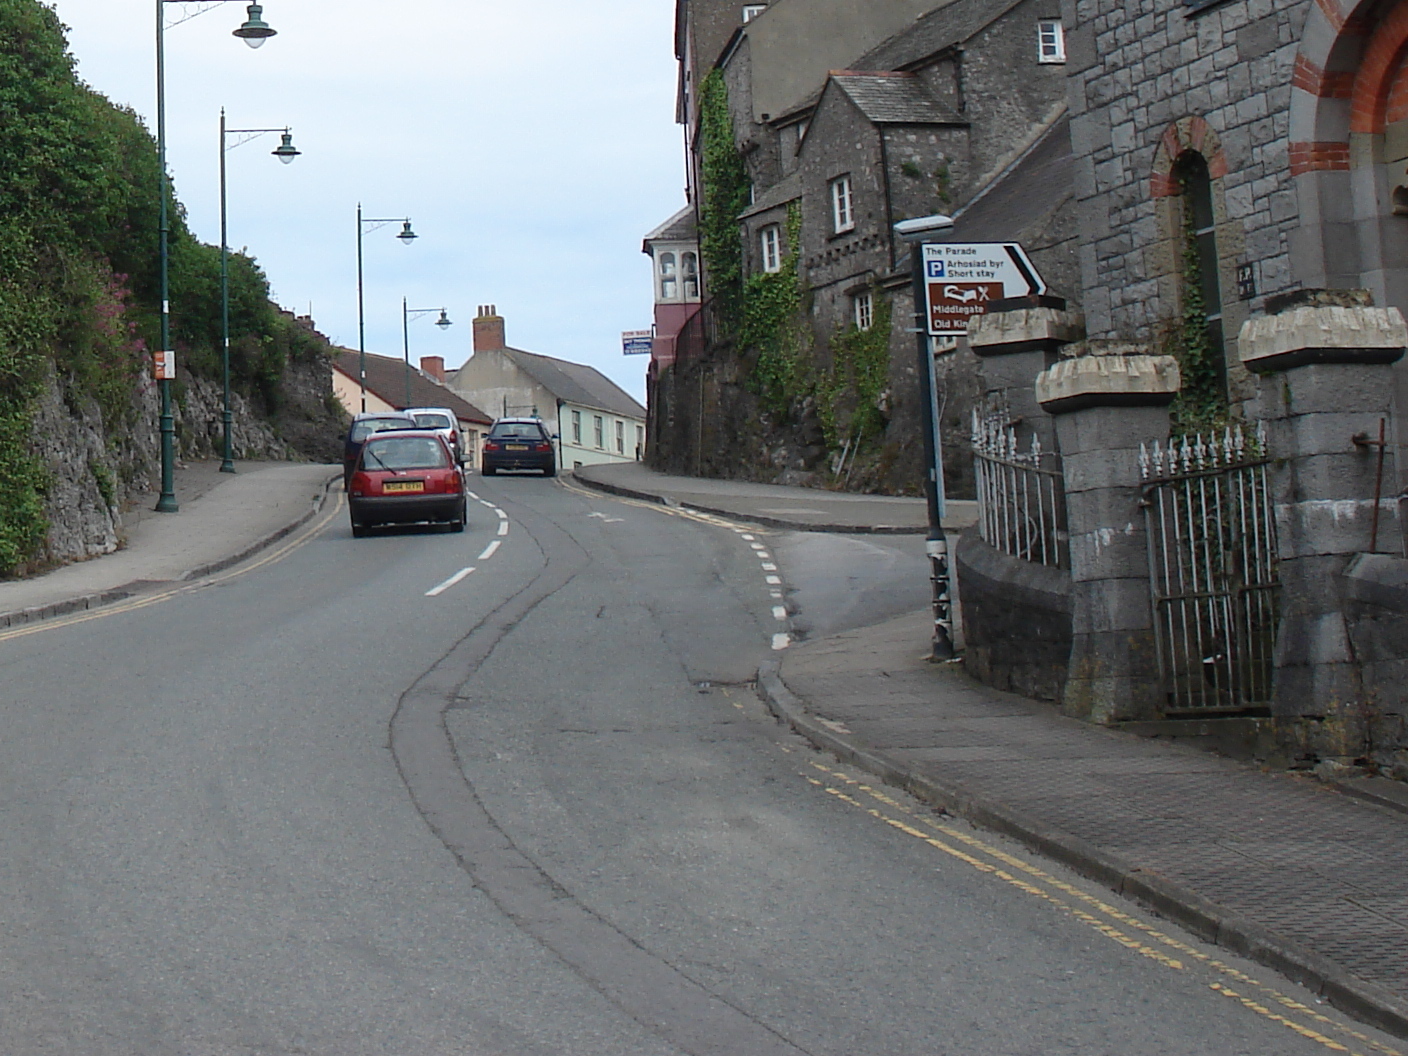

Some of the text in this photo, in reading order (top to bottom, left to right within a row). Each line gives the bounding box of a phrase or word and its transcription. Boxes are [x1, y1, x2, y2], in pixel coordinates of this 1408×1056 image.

[926, 247, 976, 255] The Parade
[931, 261, 942, 276] P
[947, 260, 1004, 269] Arhosiad byr
[948, 269, 995, 279] Short stay
[933, 305, 984, 315] Middlegate
[934, 319, 969, 328] Old Kin
